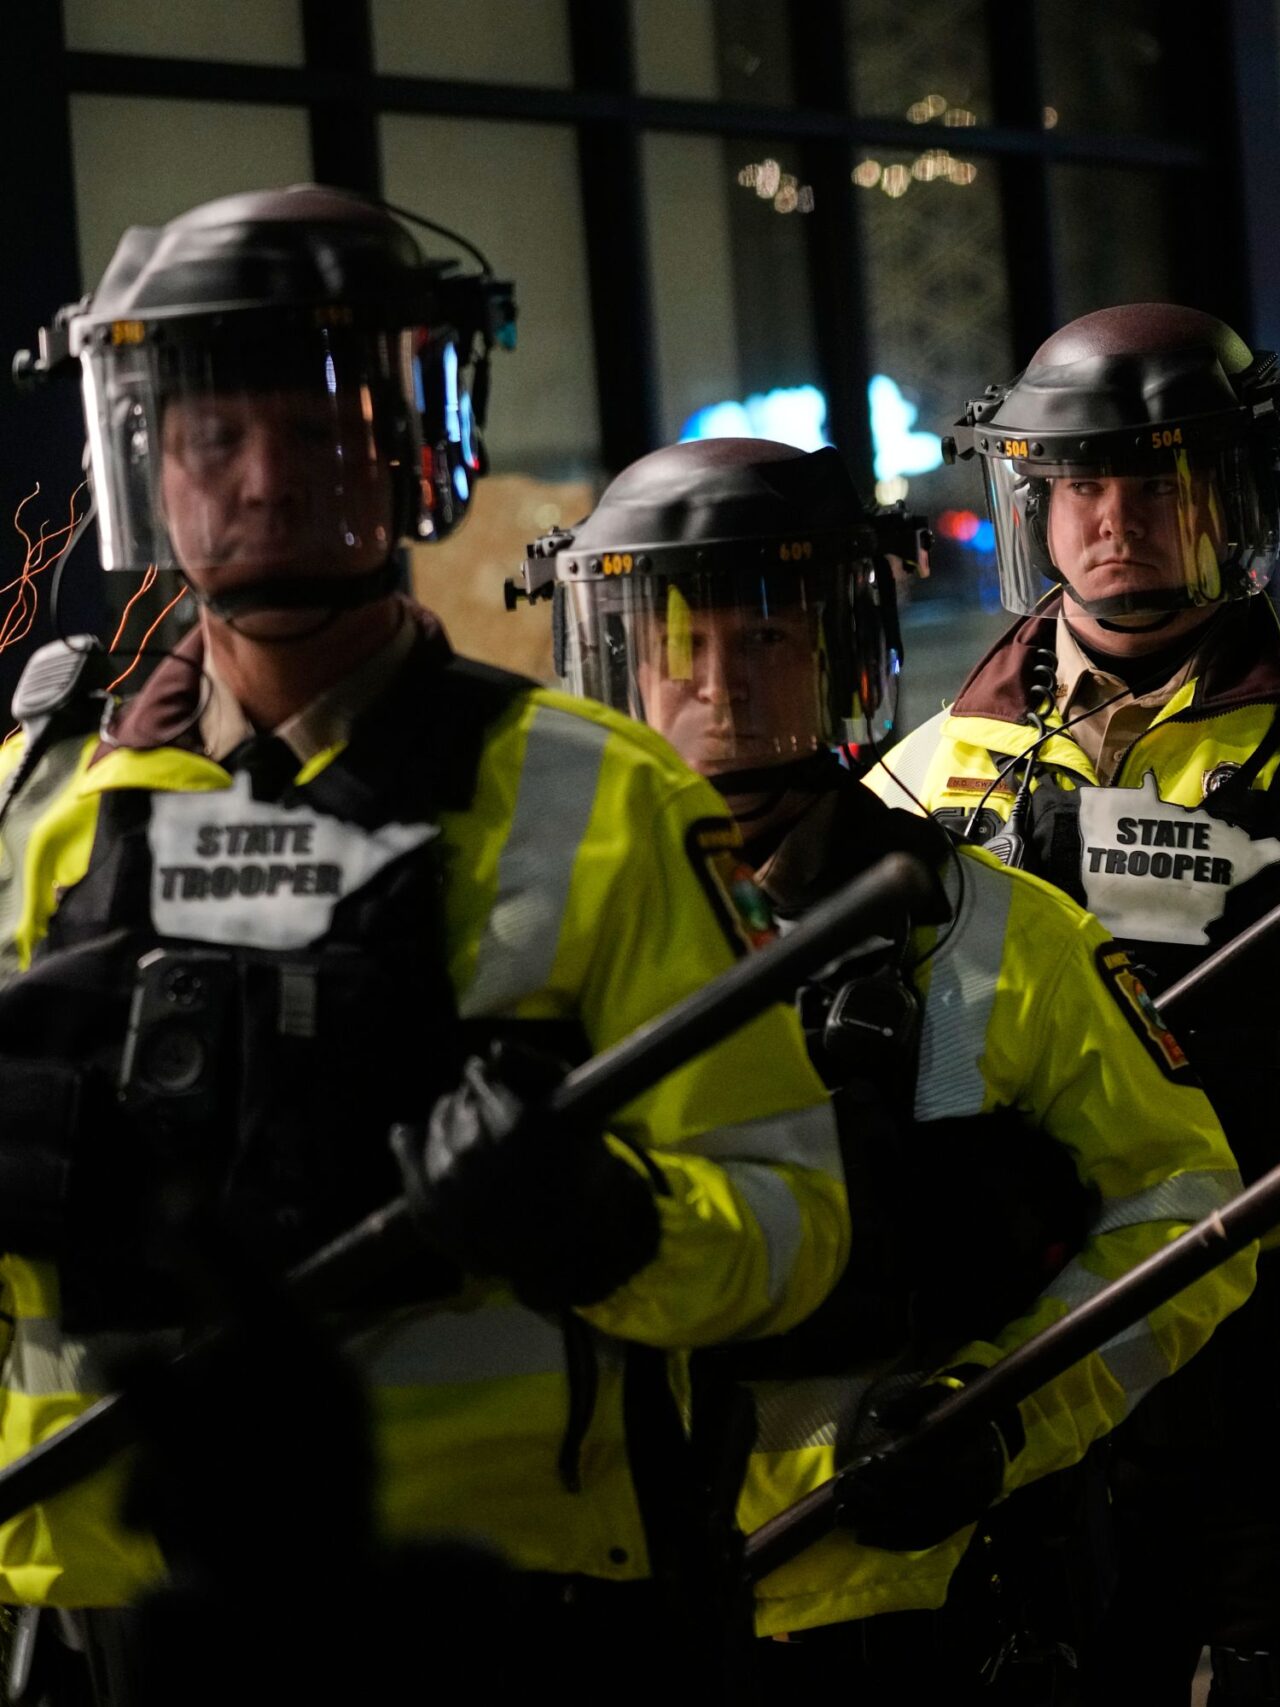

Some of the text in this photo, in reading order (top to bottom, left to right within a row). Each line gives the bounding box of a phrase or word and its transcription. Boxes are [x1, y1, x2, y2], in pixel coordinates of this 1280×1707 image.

[1005, 439, 1029, 458] 504
[1152, 428, 1183, 449] 504
[602, 553, 635, 576] 609
[780, 541, 813, 561] 609
[197, 824, 315, 858] STATE
[1117, 818, 1211, 850] STATE
[1088, 847, 1232, 885] TROOPER
[161, 864, 343, 901] TROOPER
